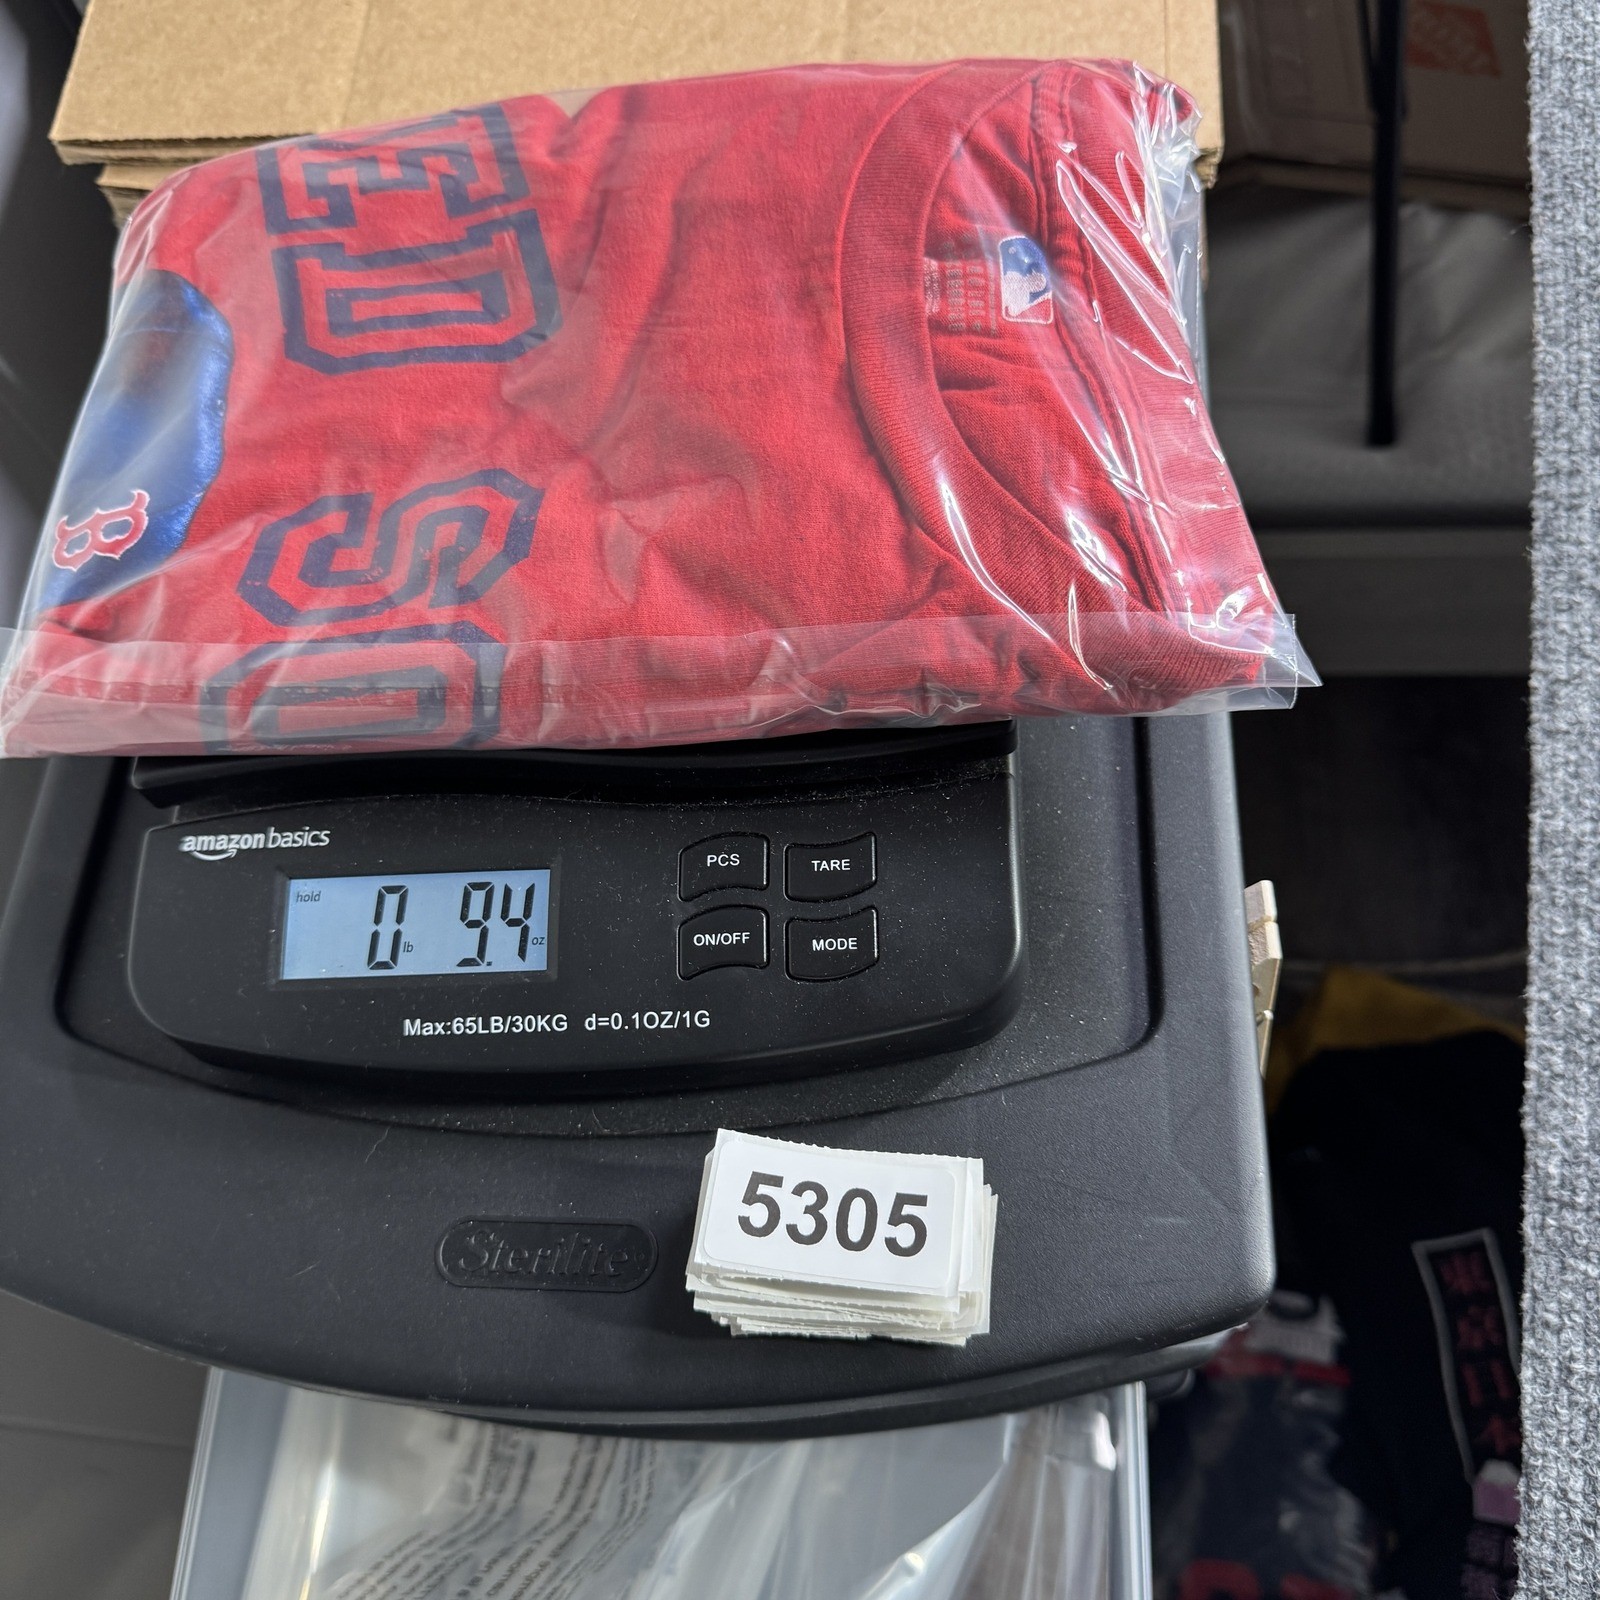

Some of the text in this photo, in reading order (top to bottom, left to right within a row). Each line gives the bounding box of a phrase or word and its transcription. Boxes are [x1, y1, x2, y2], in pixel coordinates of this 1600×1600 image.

[52, 489, 150, 572] B
[706, 853, 740, 867] PCS
[811, 859, 851, 872] TARE
[295, 890, 321, 903] hold
[367, 884, 409, 971] 0
[402, 940, 414, 954] lb
[531, 935, 546, 946] oz
[693, 932, 750, 947] ON/OFF
[812, 937, 858, 951] MODE
[403, 1010, 711, 1036] Max:65LB/30KG d=0.1OZ/1G
[737, 1170, 929, 1258] 5305
[457, 1229, 630, 1278] Sterilite
